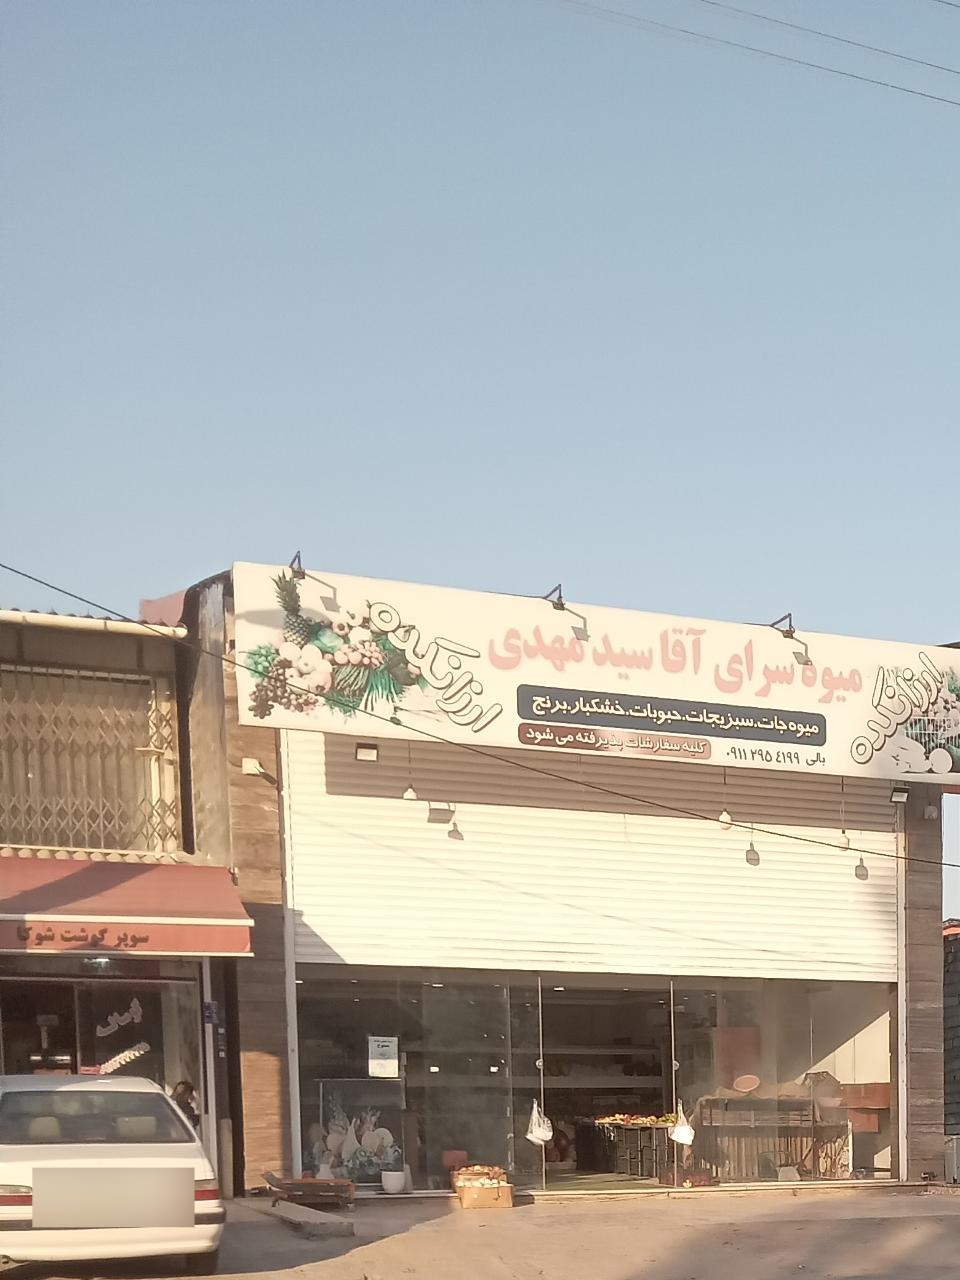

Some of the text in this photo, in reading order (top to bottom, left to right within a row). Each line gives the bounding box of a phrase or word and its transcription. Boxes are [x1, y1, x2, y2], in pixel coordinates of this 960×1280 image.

[369, 601, 503, 733] ارزانکده
[488, 625, 863, 704] میوه سرای آقا سید مهدی
[850, 651, 943, 765] ارزانکده
[625, 735, 681, 753] سفارشات
[682, 741, 706, 757] کلیه
[61, 927, 108, 946] گوشت
[113, 932, 149, 948] سوپر
